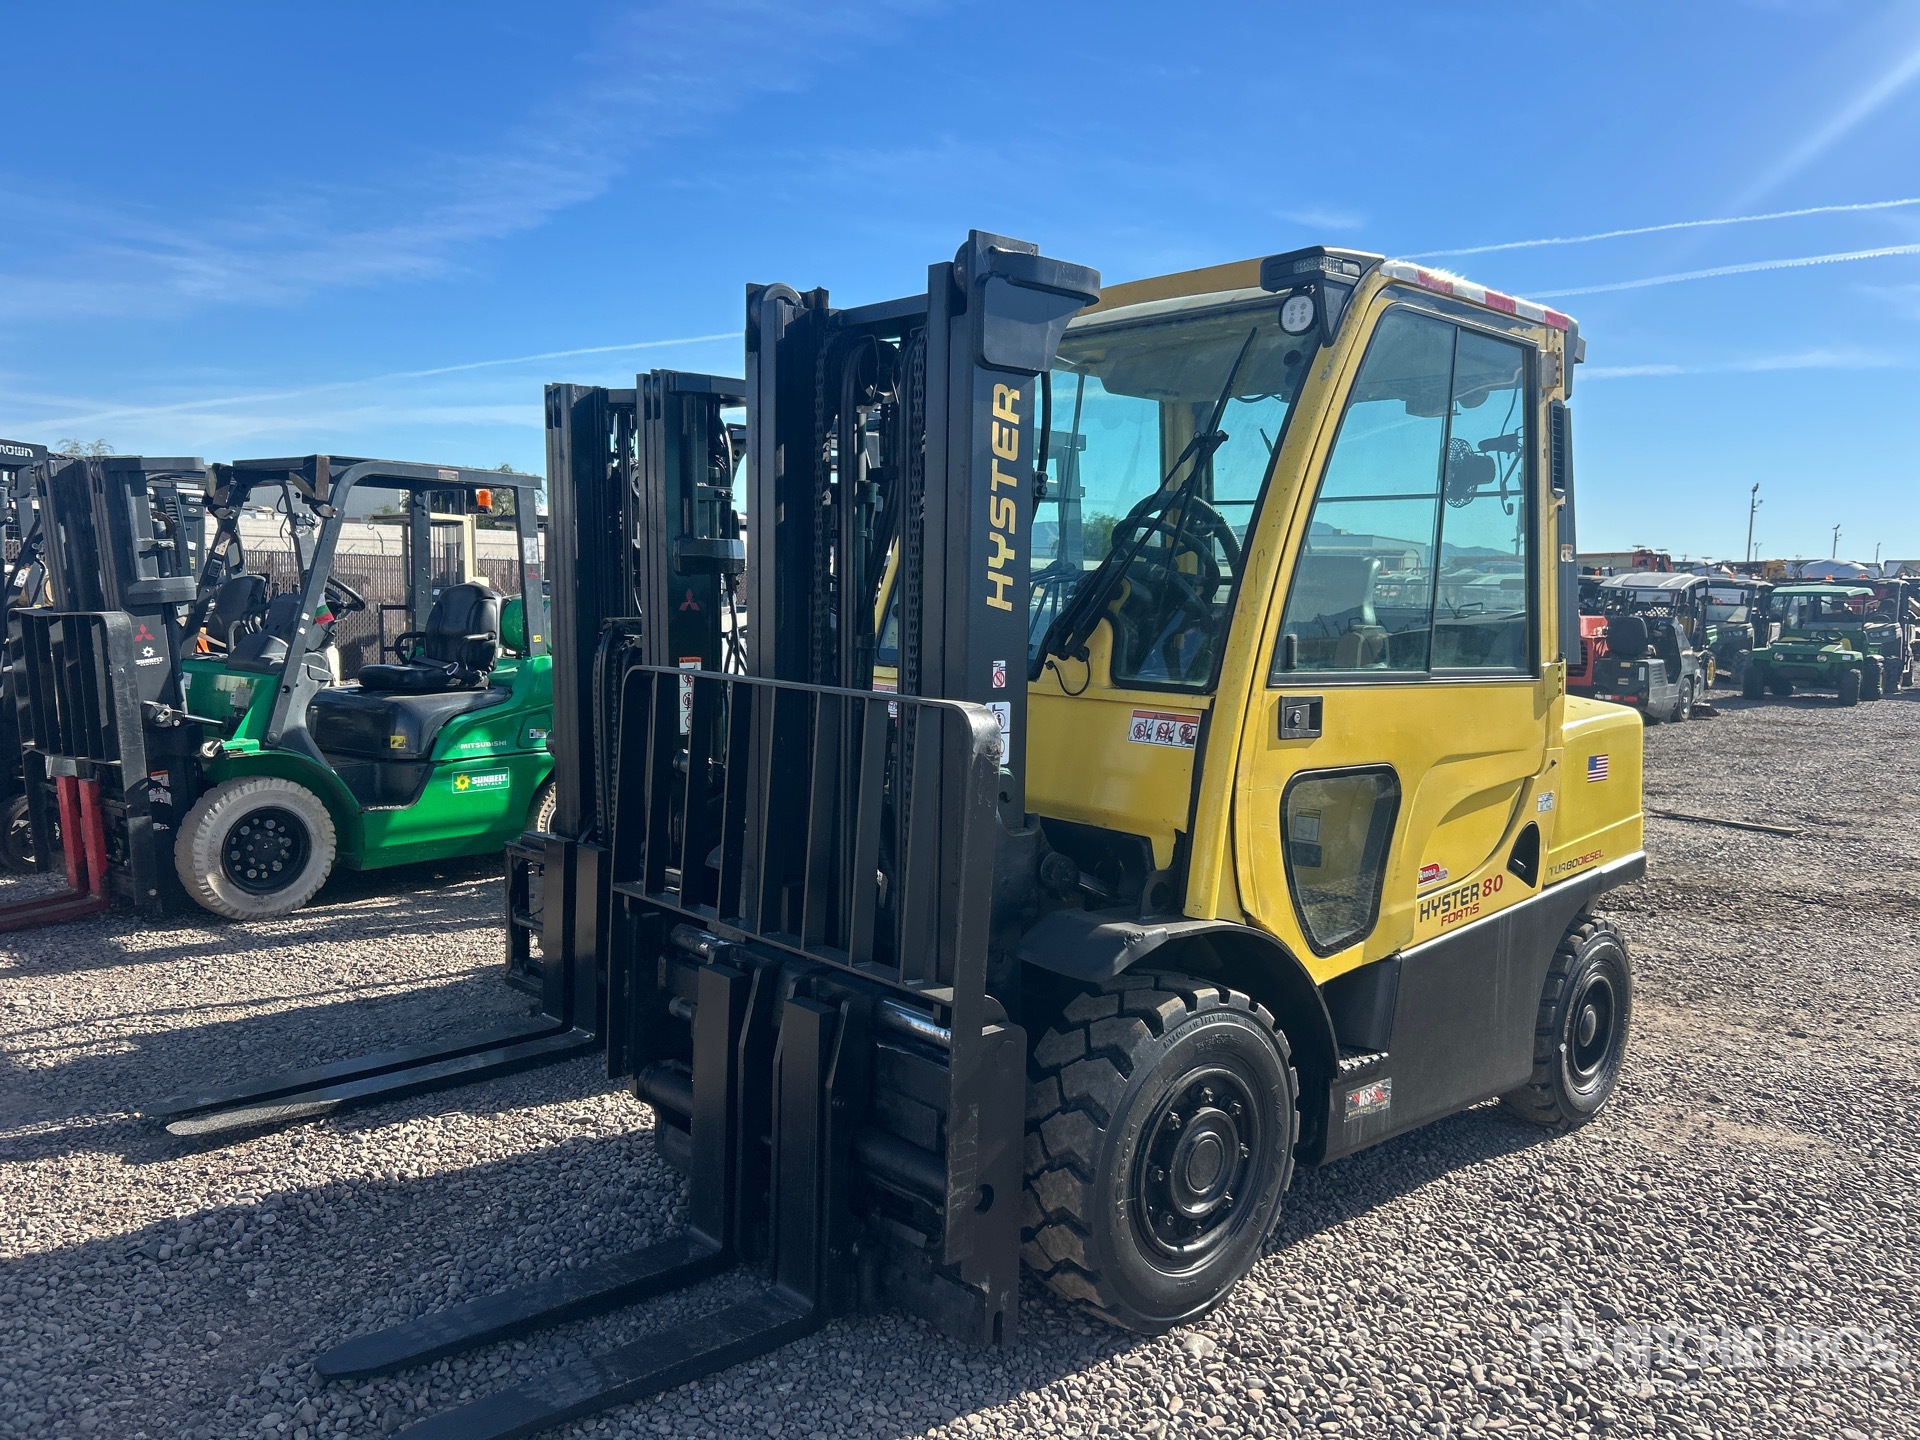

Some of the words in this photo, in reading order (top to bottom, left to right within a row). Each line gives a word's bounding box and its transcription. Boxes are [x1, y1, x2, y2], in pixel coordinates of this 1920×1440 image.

[0, 444, 34, 458] ROWN
[986, 383, 1021, 613] HYSTER
[460, 740, 507, 750] MITSUBISHI
[471, 773, 508, 785] SUNBELT
[1548, 848, 1605, 876] TURBODIESEL
[1419, 882, 1480, 923] HYSTER
[1481, 874, 1504, 898] 80
[1440, 902, 1480, 927] FORTIS
